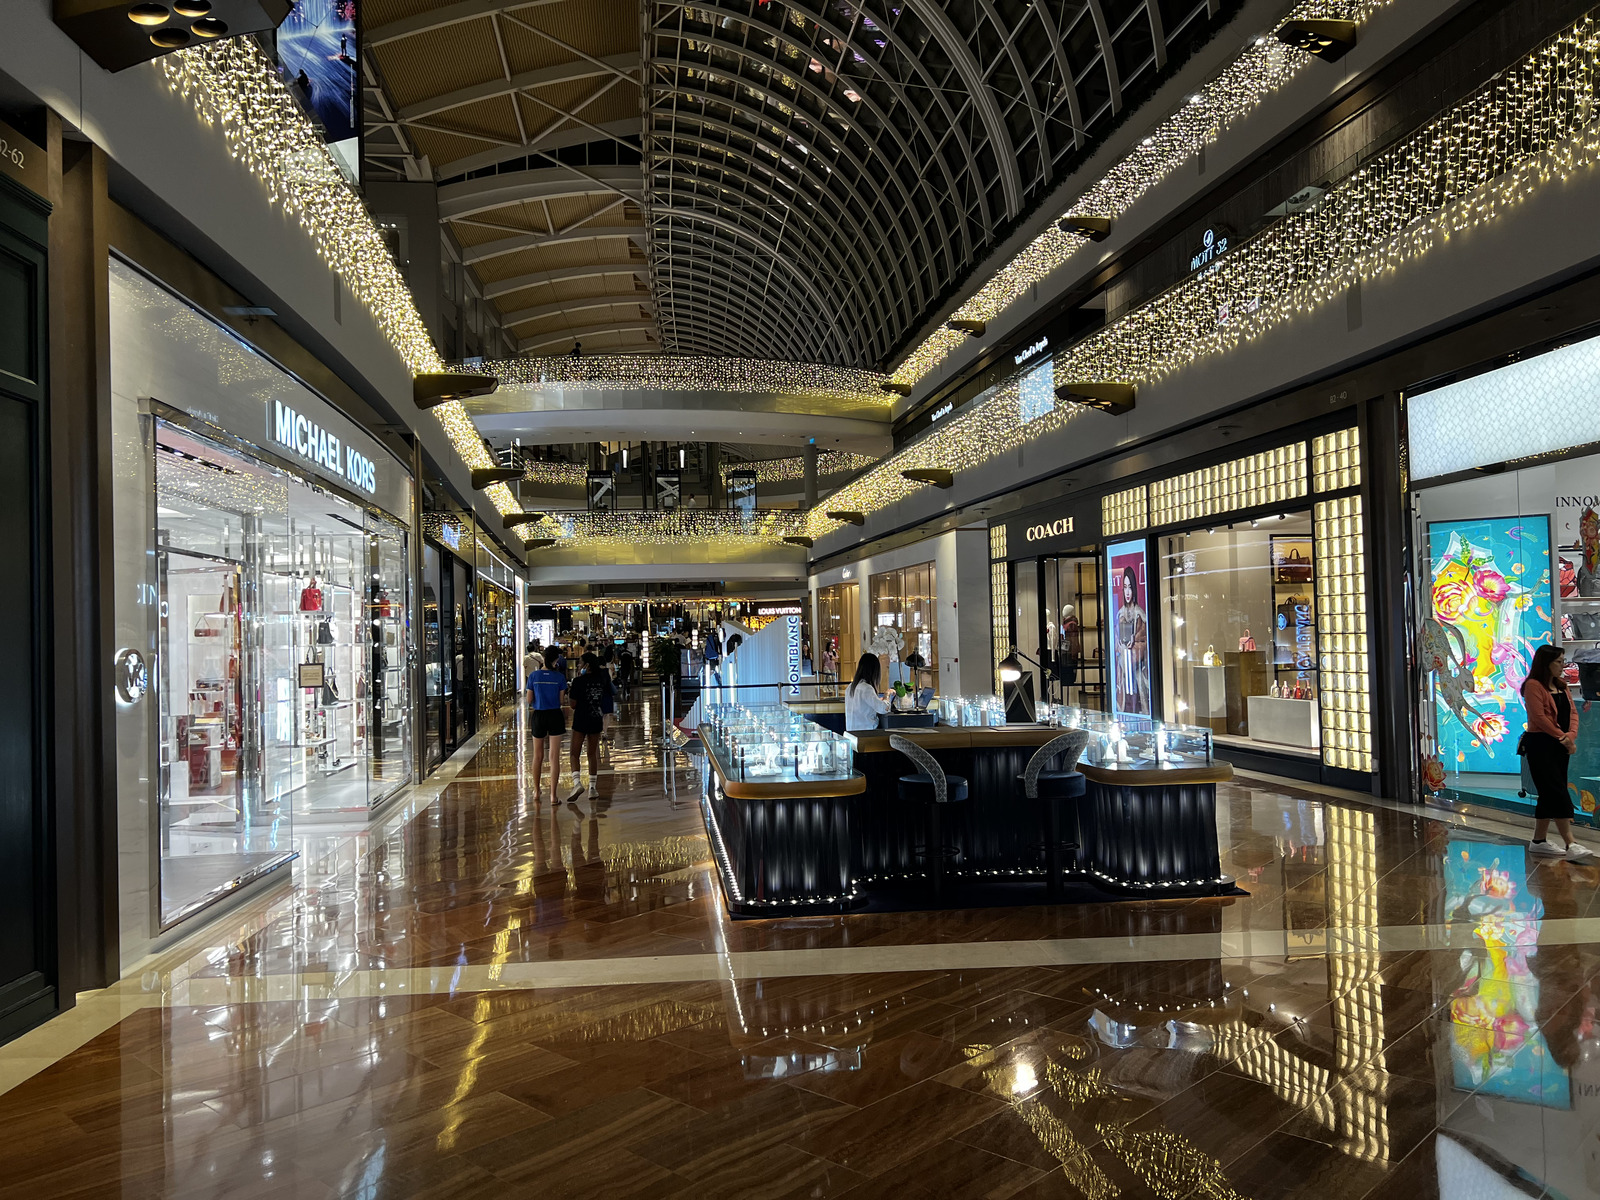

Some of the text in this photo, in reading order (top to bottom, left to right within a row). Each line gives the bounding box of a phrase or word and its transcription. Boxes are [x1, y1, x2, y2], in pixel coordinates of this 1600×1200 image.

[0, 138, 25, 169] 2-62
[1190, 244, 1215, 272] MOTT
[275, 399, 376, 494] MICHAEL KORS
[1026, 517, 1074, 541] COACH
[758, 606, 802, 615] LOUIS VUITTON
[787, 615, 800, 695] MONTBLANC
